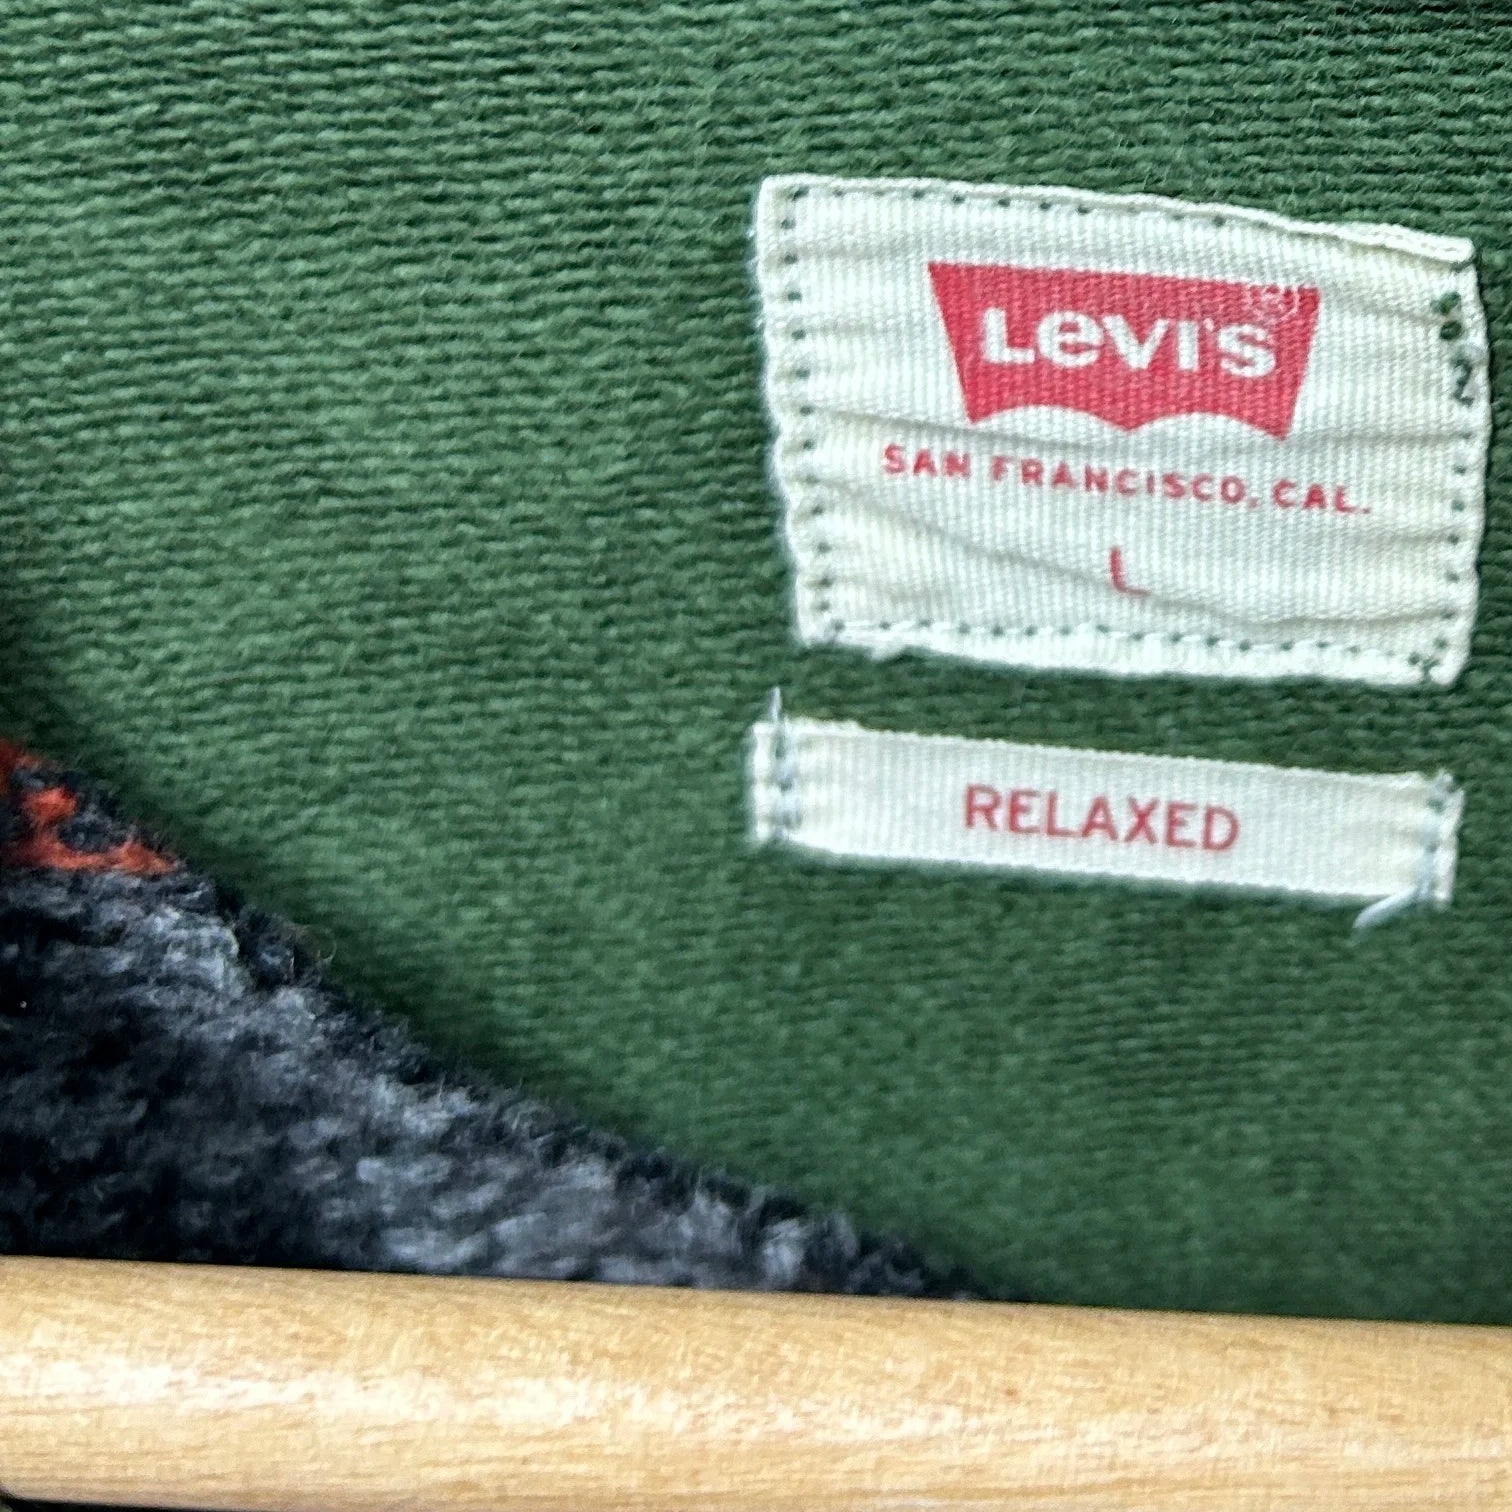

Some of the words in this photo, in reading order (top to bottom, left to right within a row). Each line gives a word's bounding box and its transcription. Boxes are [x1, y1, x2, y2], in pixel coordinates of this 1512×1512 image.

[882, 442, 971, 481] SAN
[989, 453, 1260, 508] FRANCISCO,
[1270, 477, 1373, 515] CAL.
[1108, 544, 1152, 596] L
[964, 782, 1241, 852] RELAXED
